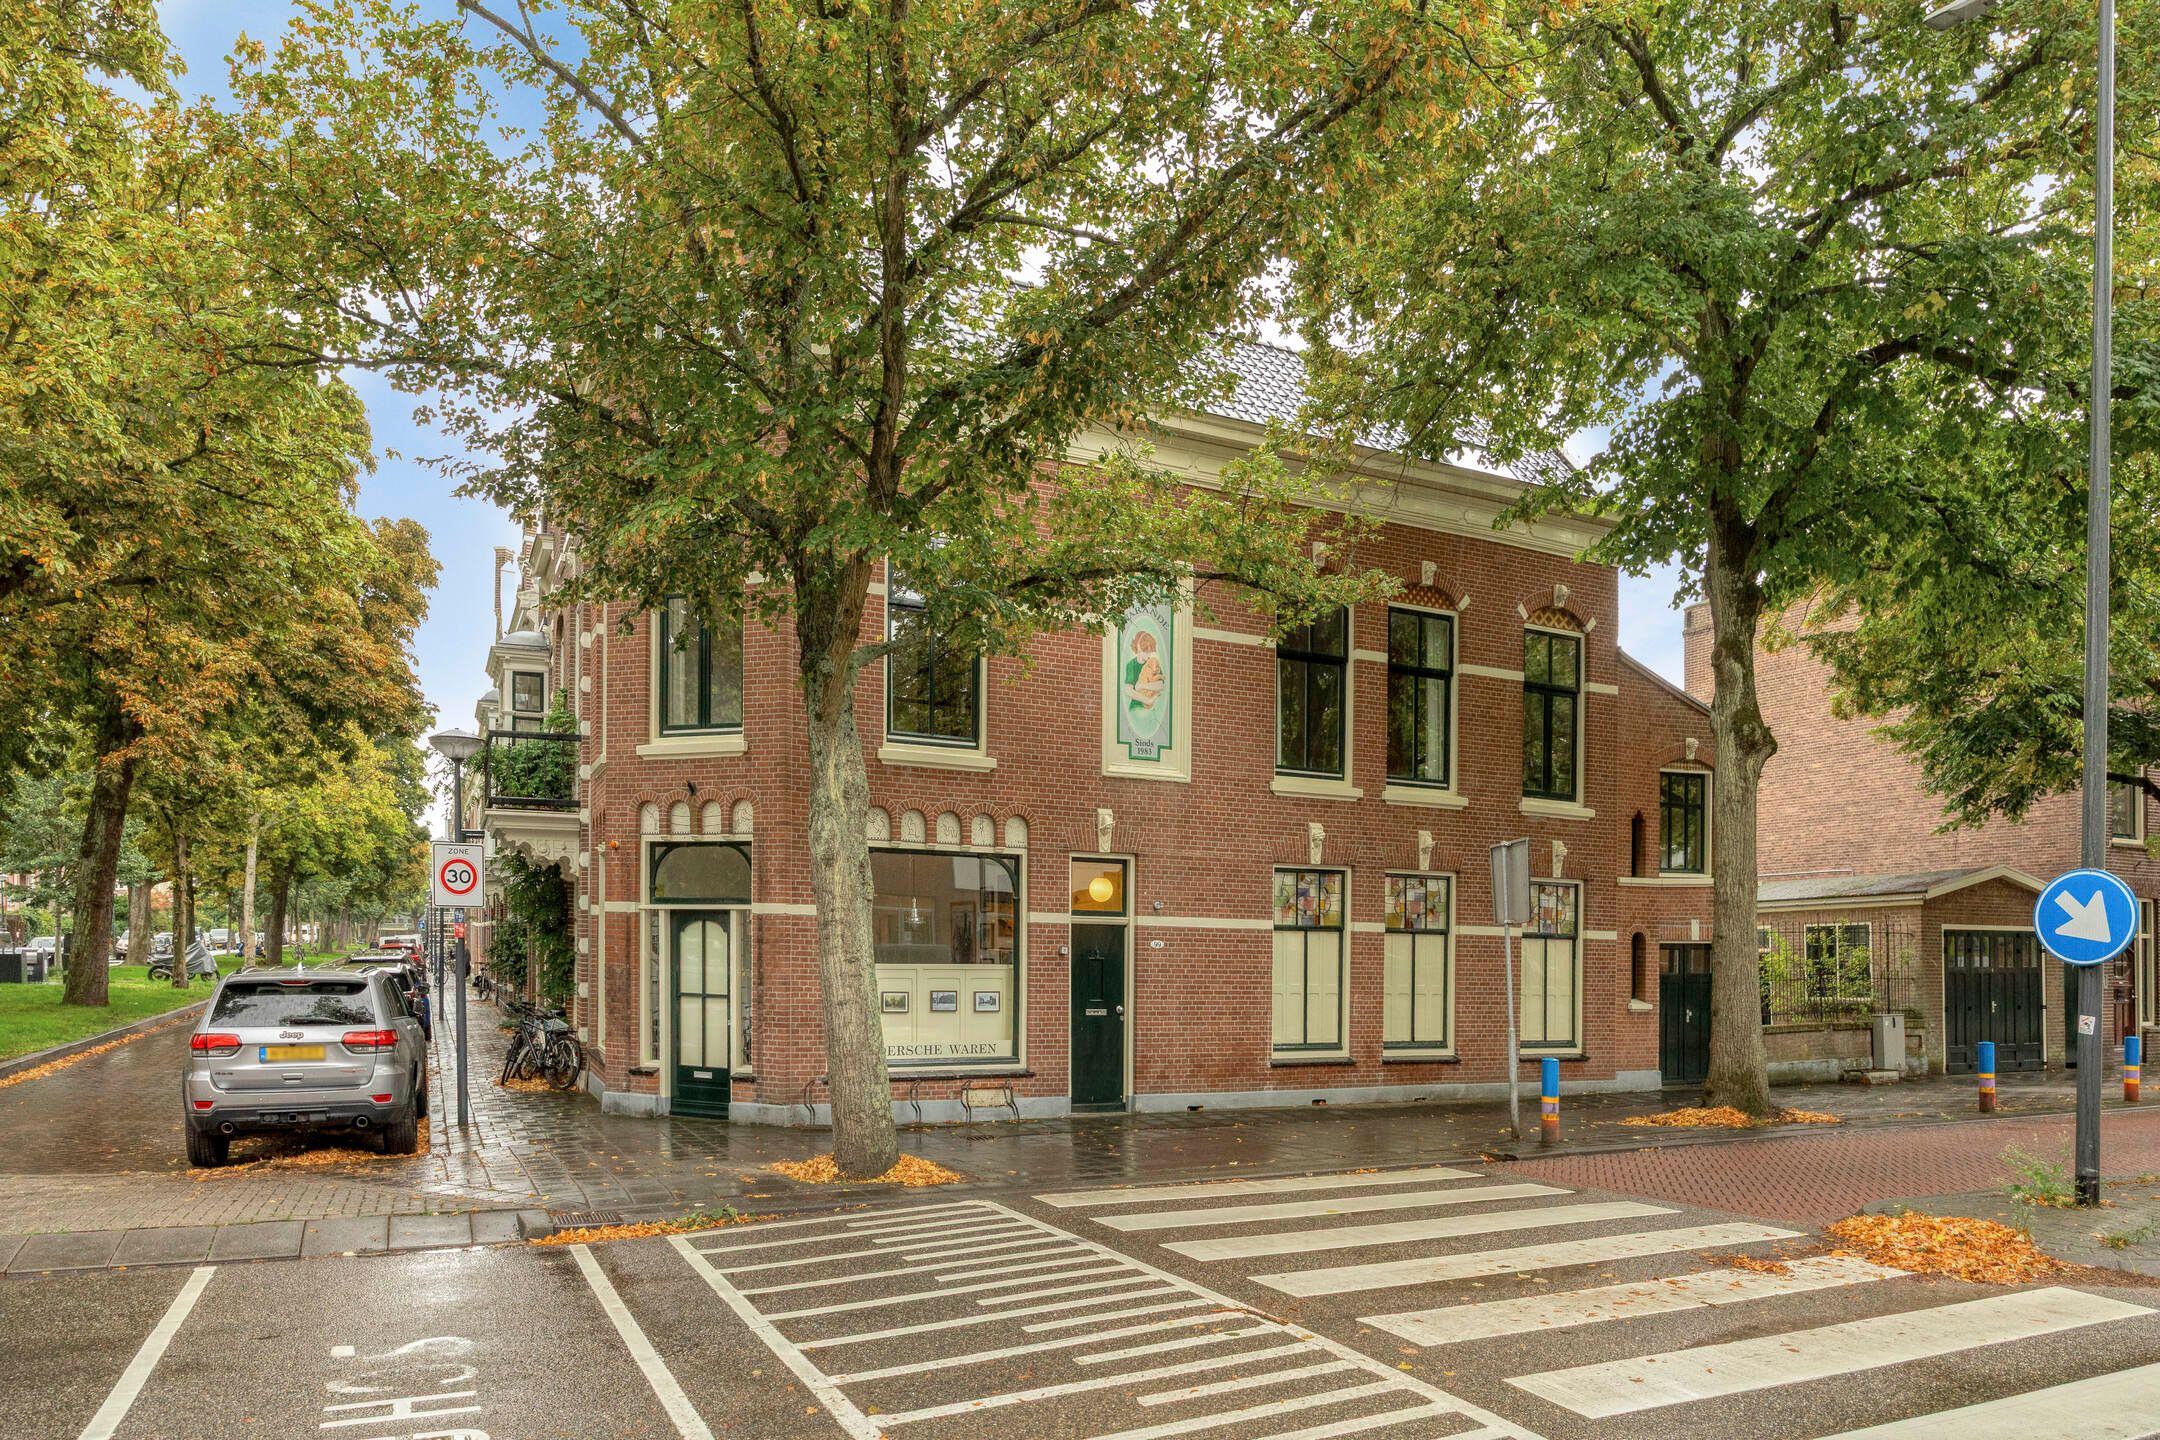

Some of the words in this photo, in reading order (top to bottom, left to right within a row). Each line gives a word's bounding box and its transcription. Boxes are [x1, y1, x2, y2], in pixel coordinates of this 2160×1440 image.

[1135, 738, 1153, 747] Sinds
[1137, 747, 1152, 755] 1983
[447, 869, 471, 884] 30
[279, 1031, 304, 1040] Jeep
[950, 1044, 996, 1055] WAREN
